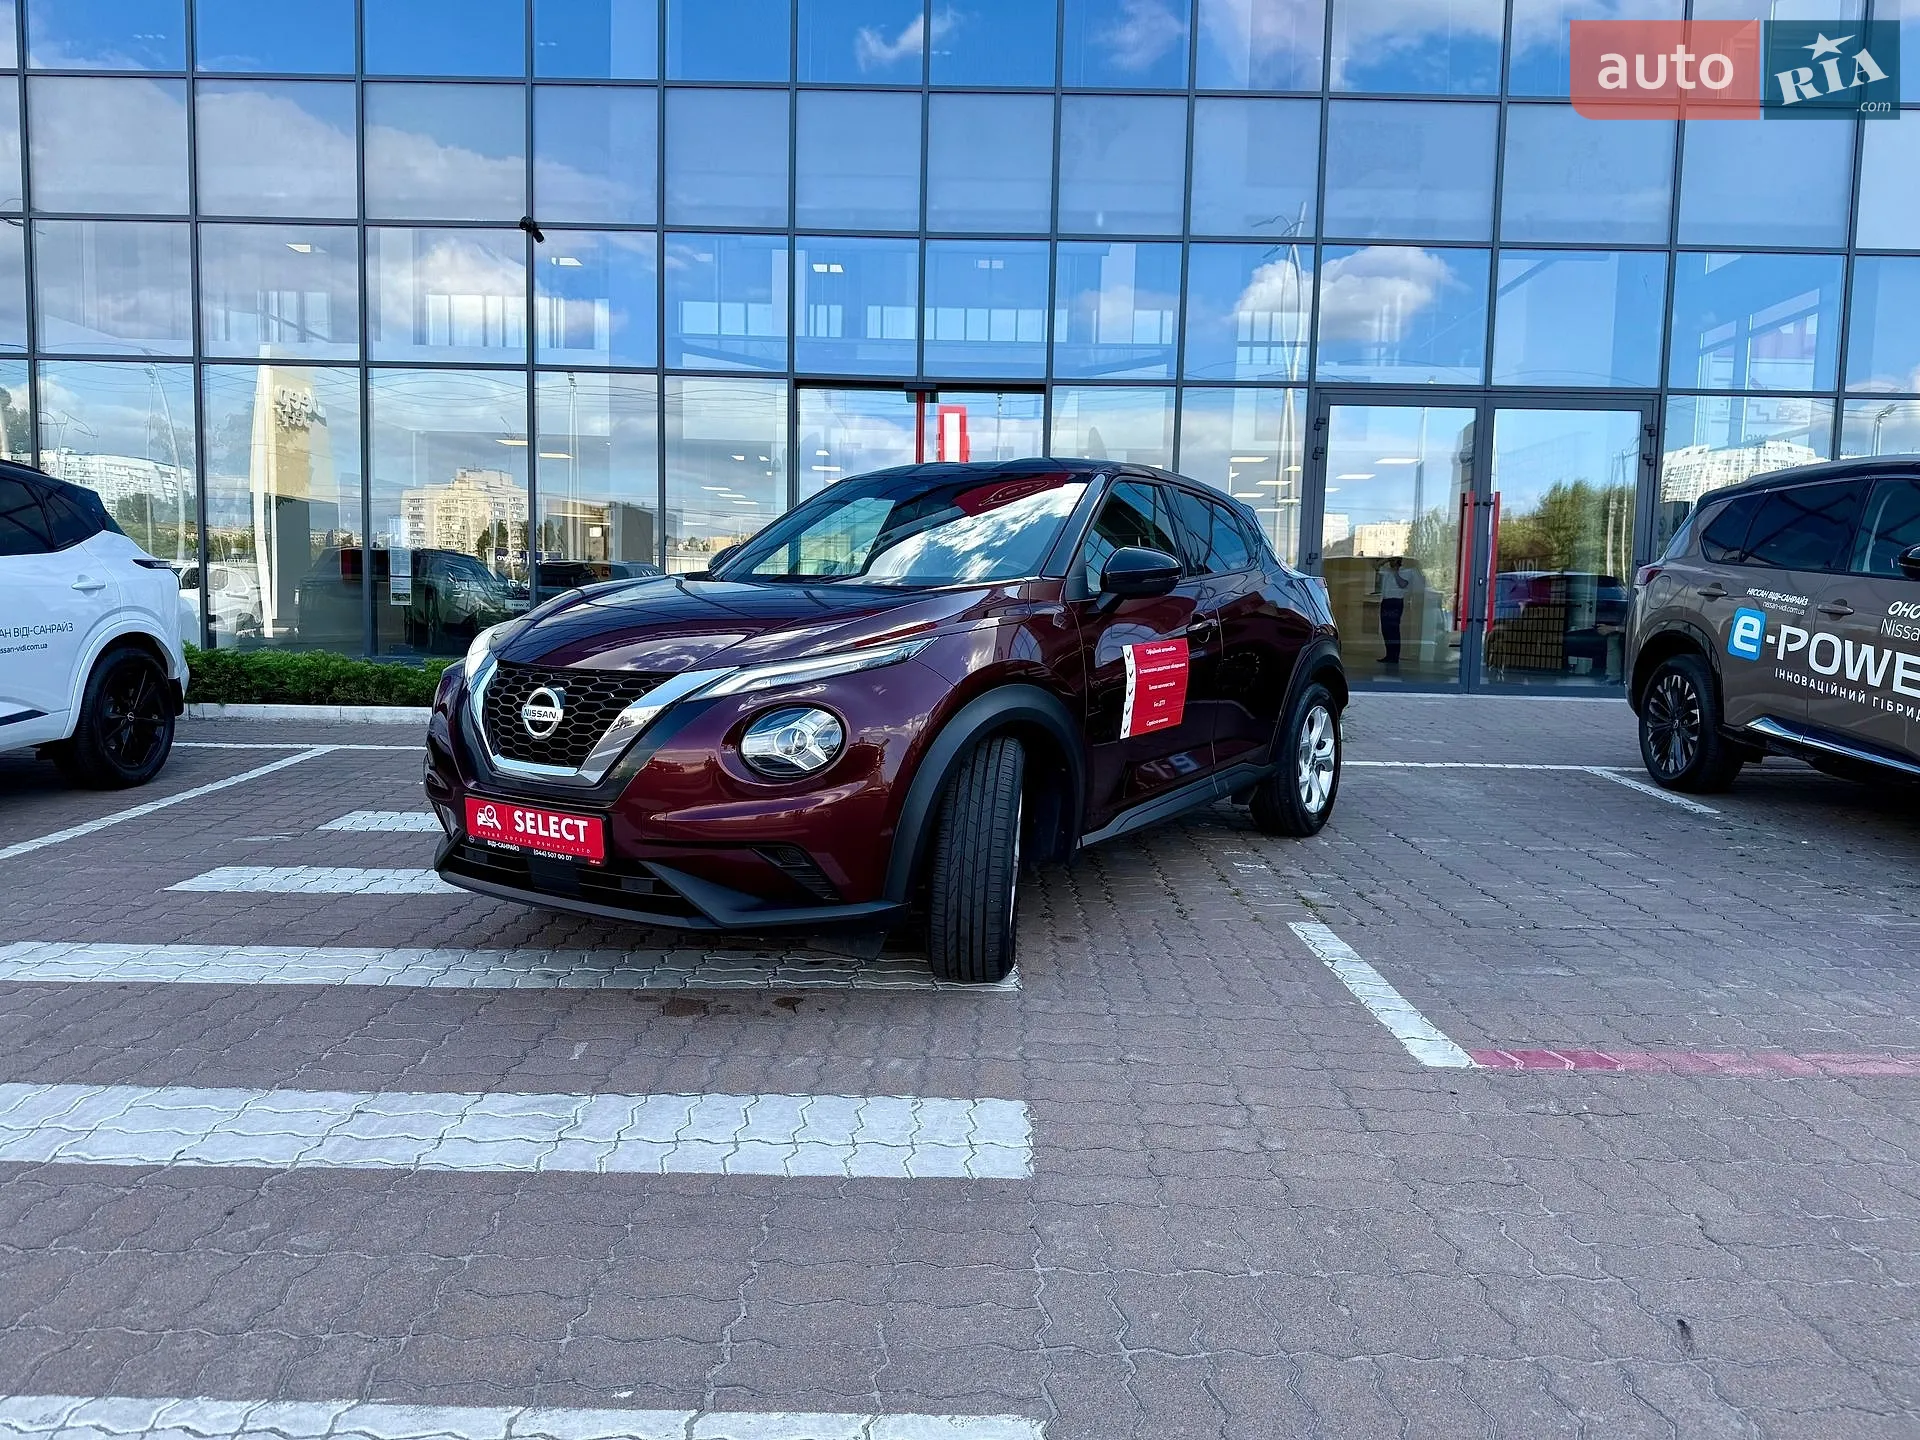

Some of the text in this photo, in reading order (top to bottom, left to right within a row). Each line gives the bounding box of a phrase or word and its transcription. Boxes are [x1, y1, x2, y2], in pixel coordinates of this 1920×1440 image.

[13, 621, 74, 638] ВІДІ-САНРАЙЗ
[1774, 667, 1866, 704] ІННОВАЦІЙНИЙ
[524, 708, 557, 719] NISSAN
[513, 810, 589, 843] SELECT
